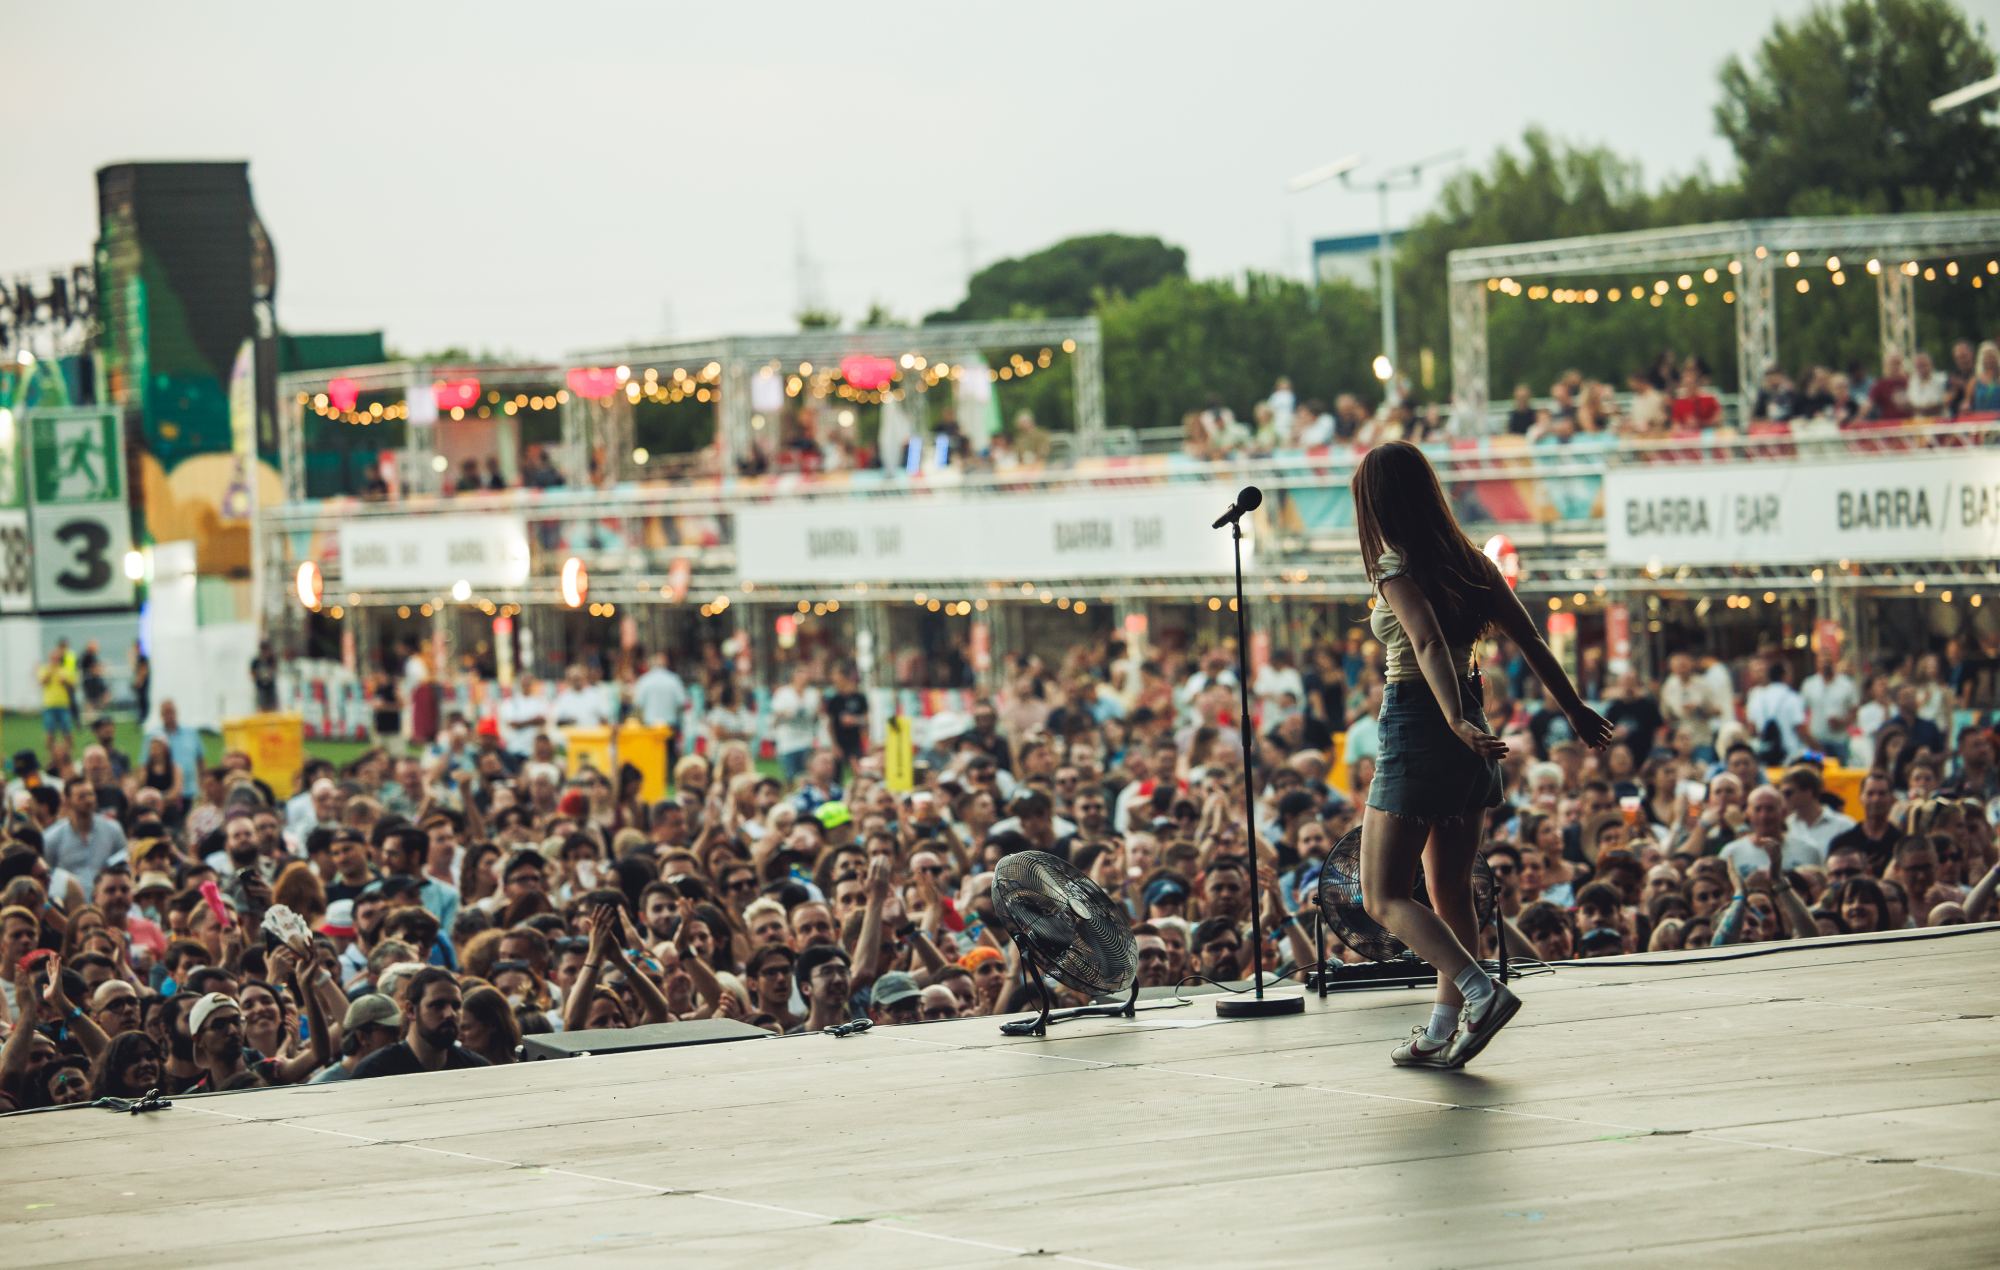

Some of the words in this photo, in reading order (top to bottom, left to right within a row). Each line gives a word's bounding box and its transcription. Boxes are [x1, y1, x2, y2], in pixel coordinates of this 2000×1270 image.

[1626, 496, 1710, 536] BARRA
[1735, 492, 1782, 533] BAR
[1838, 487, 1932, 531] BARRA
[55, 517, 112, 594] 3
